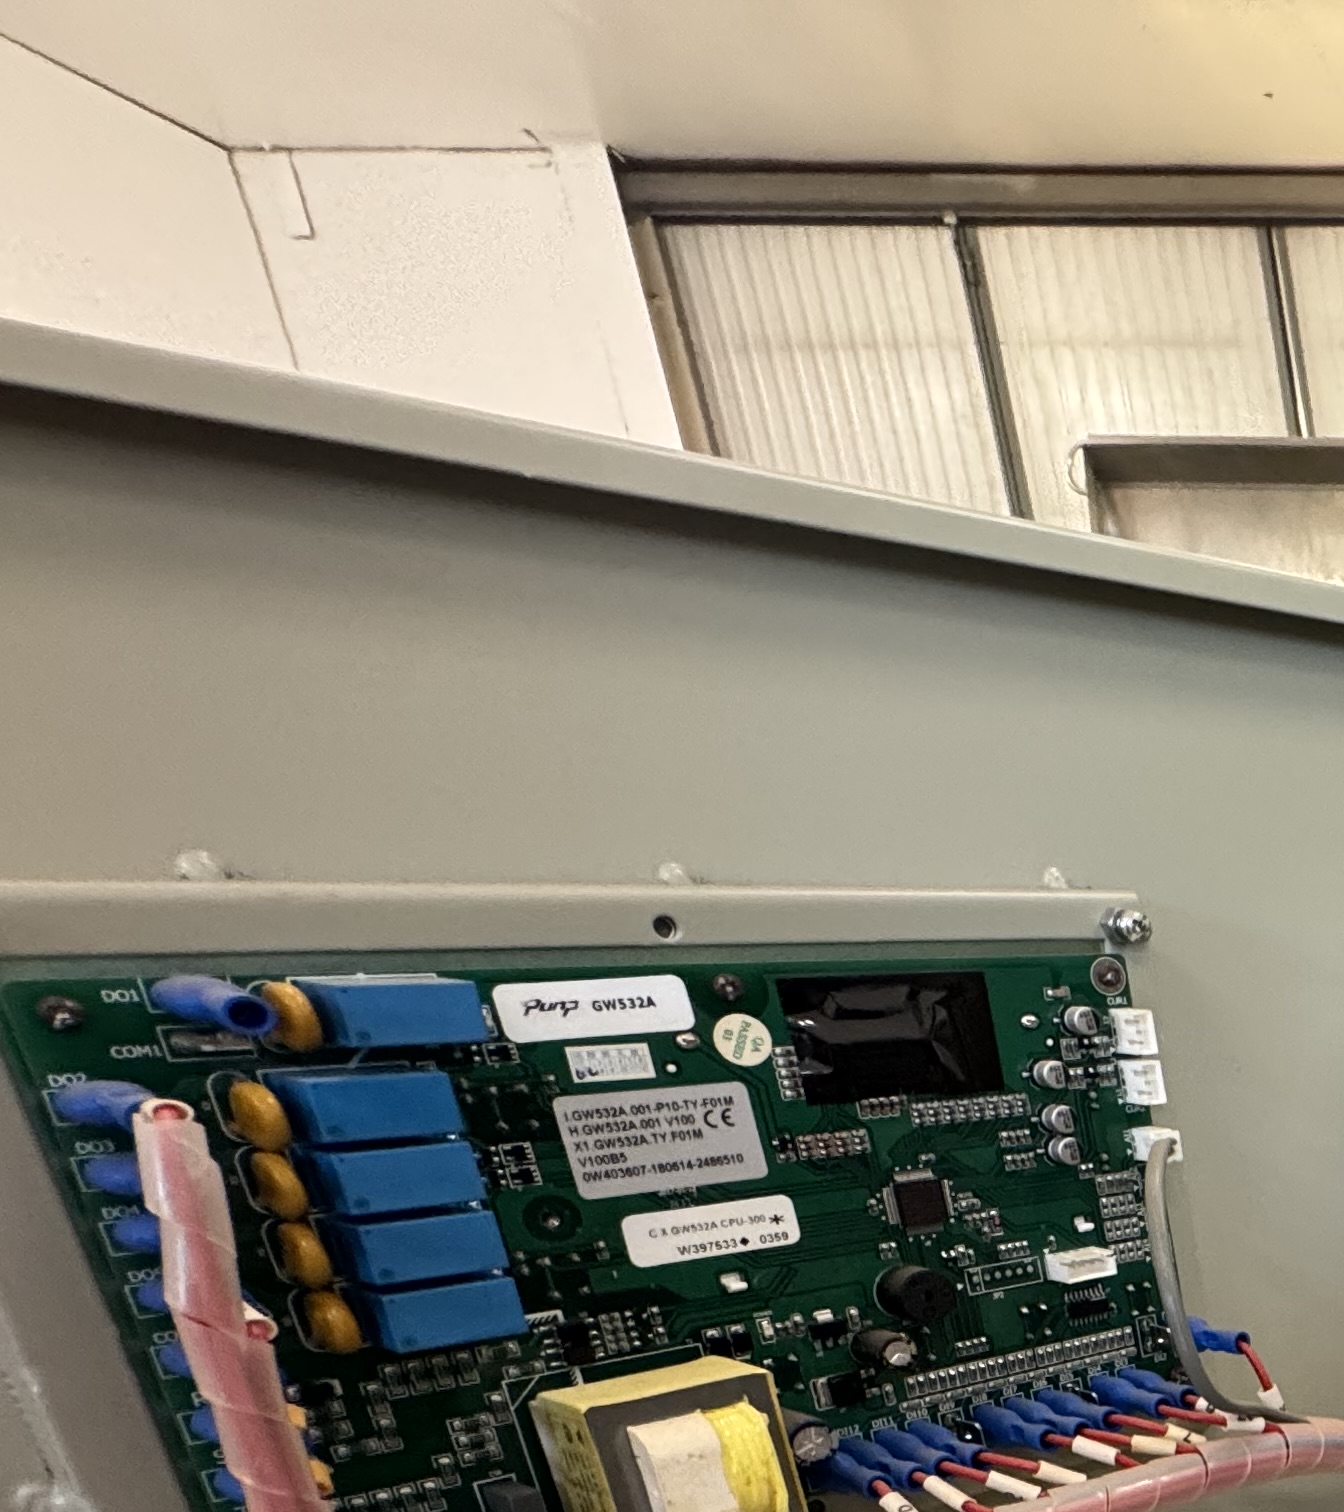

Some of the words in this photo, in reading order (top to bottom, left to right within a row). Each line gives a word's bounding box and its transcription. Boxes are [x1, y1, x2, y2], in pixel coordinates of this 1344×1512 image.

[101, 988, 140, 1003] DO1
[592, 996, 656, 1012] GW532A
[109, 1045, 163, 1059] COM1
[665, 1114, 696, 1128] V100
[871, 1416, 894, 1429] DI11
[837, 1424, 860, 1437] DI12
